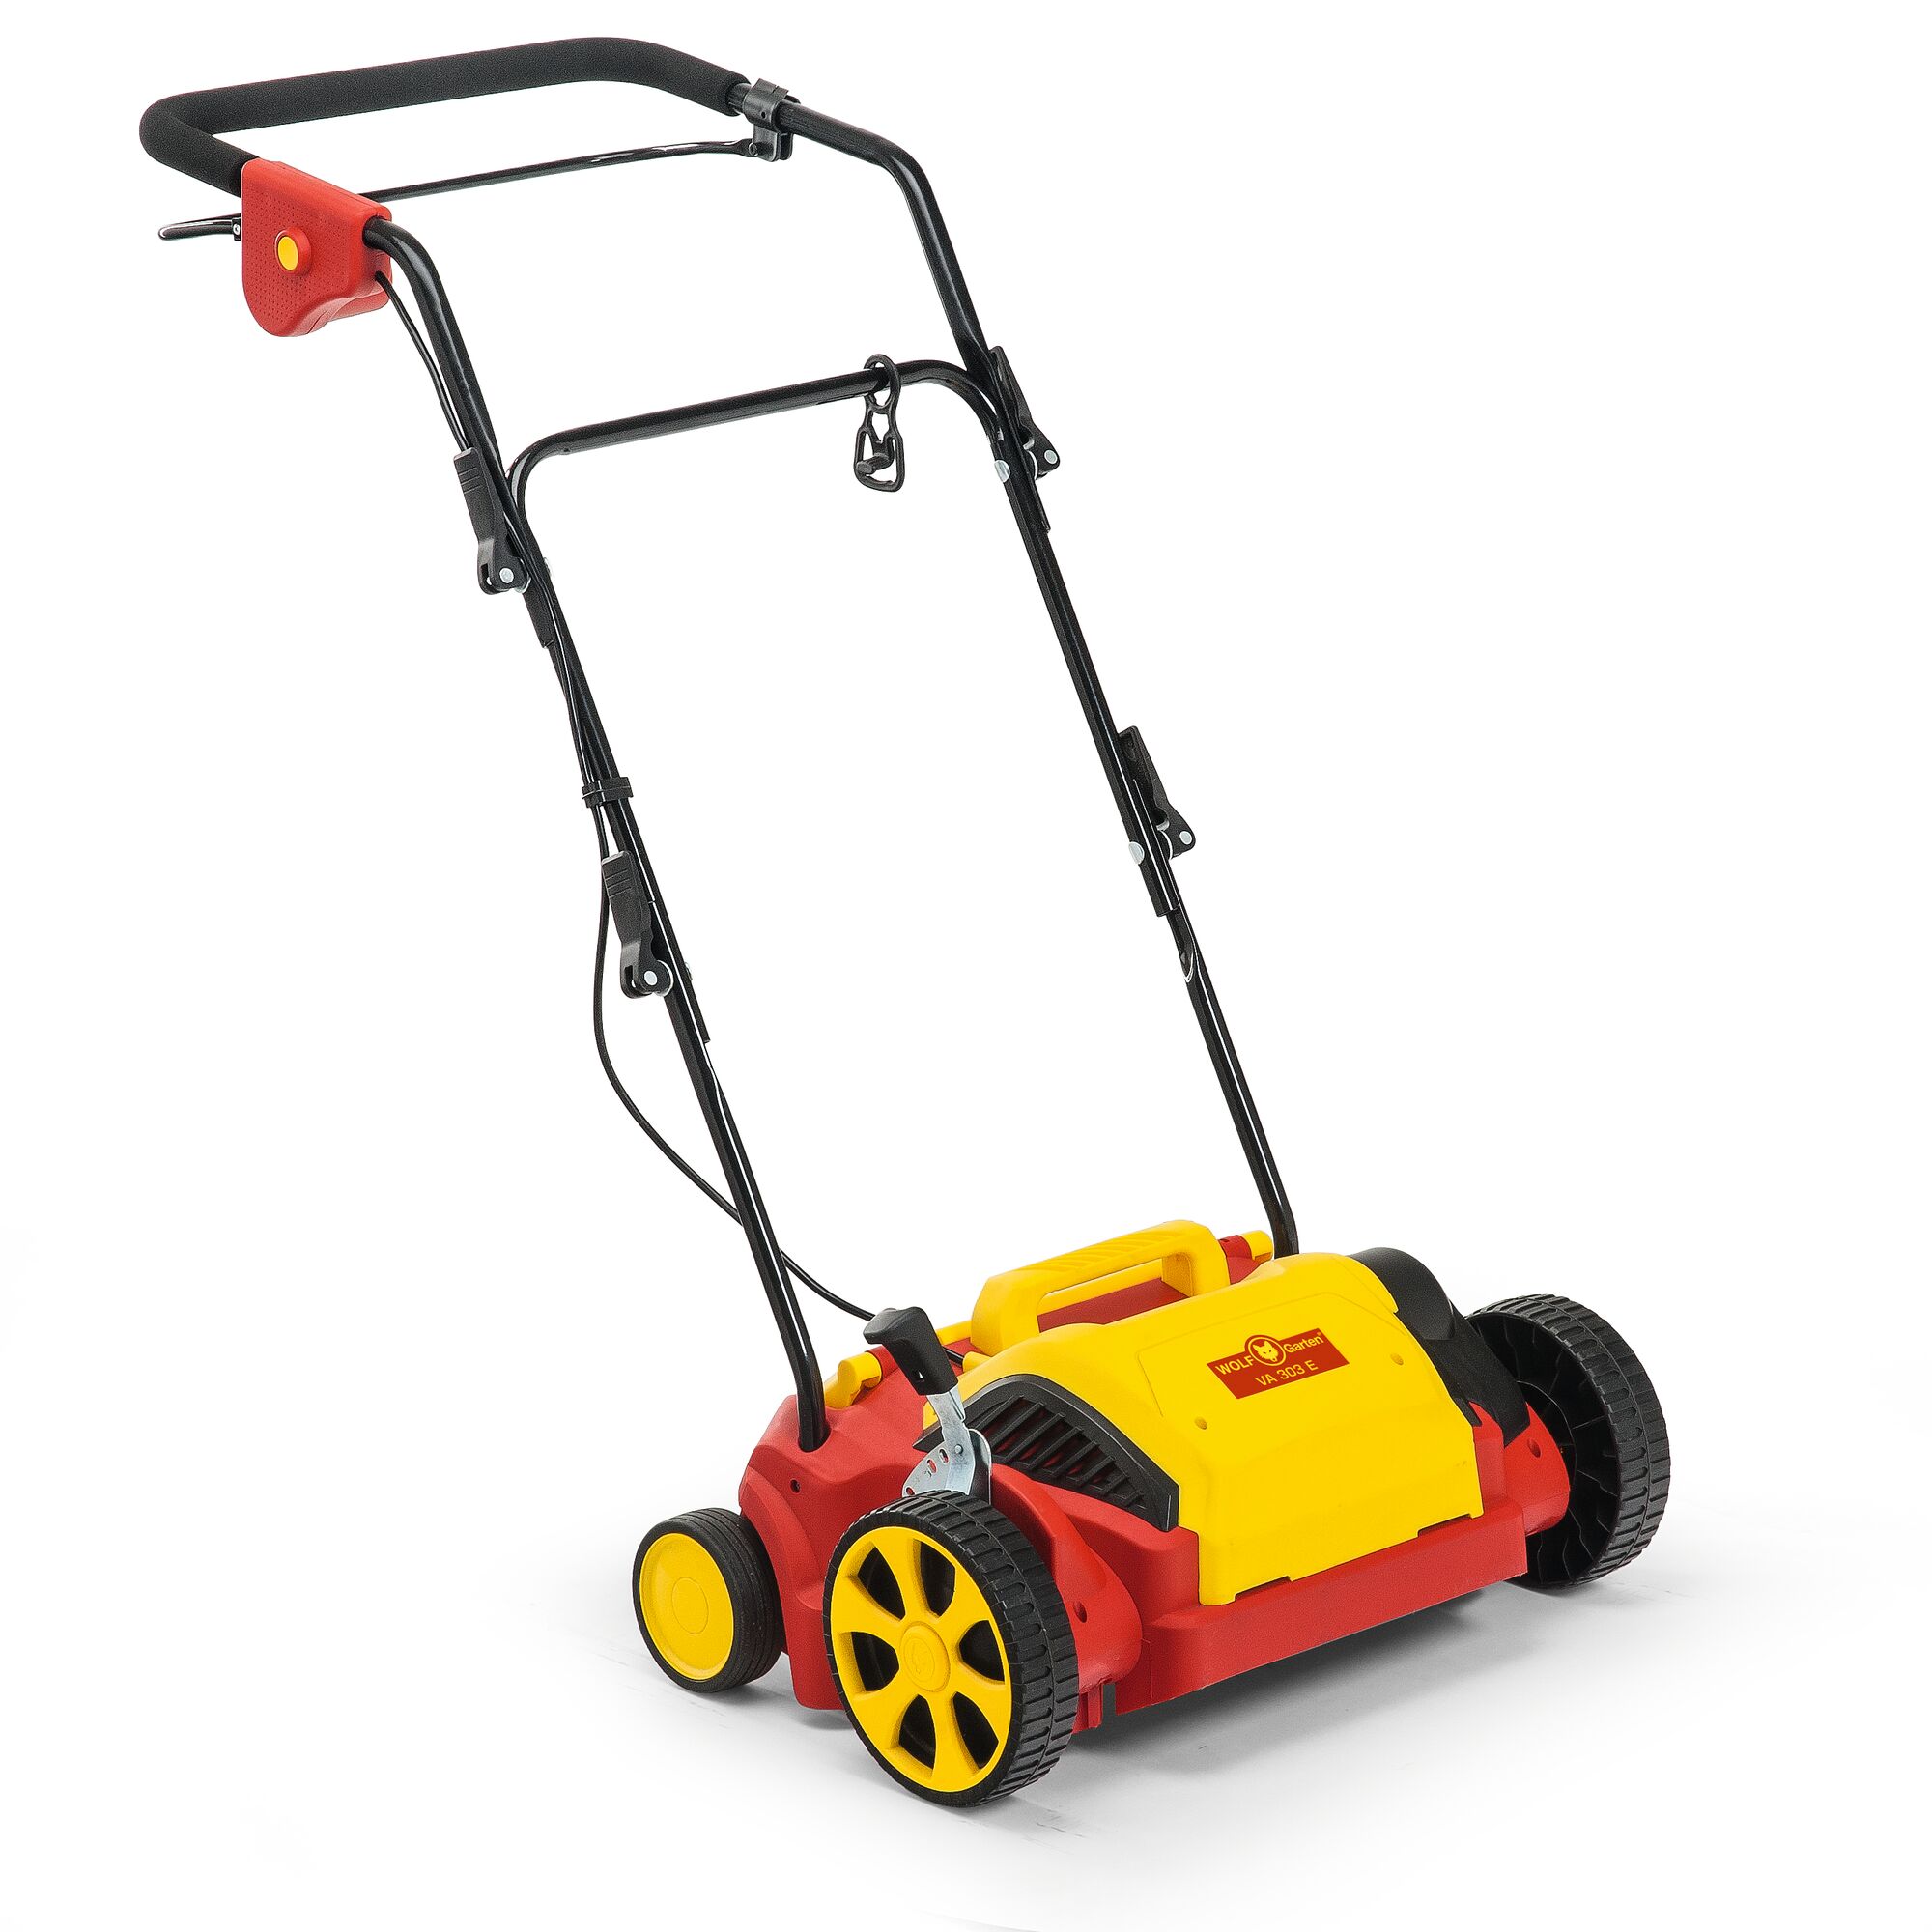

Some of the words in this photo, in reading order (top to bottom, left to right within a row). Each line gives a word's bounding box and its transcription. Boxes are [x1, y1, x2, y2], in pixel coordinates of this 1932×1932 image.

[1215, 1355, 1256, 1375] WOLF
[1255, 1374, 1278, 1386] VA
[1277, 1364, 1305, 1379] 303
[1304, 1359, 1319, 1371] E
